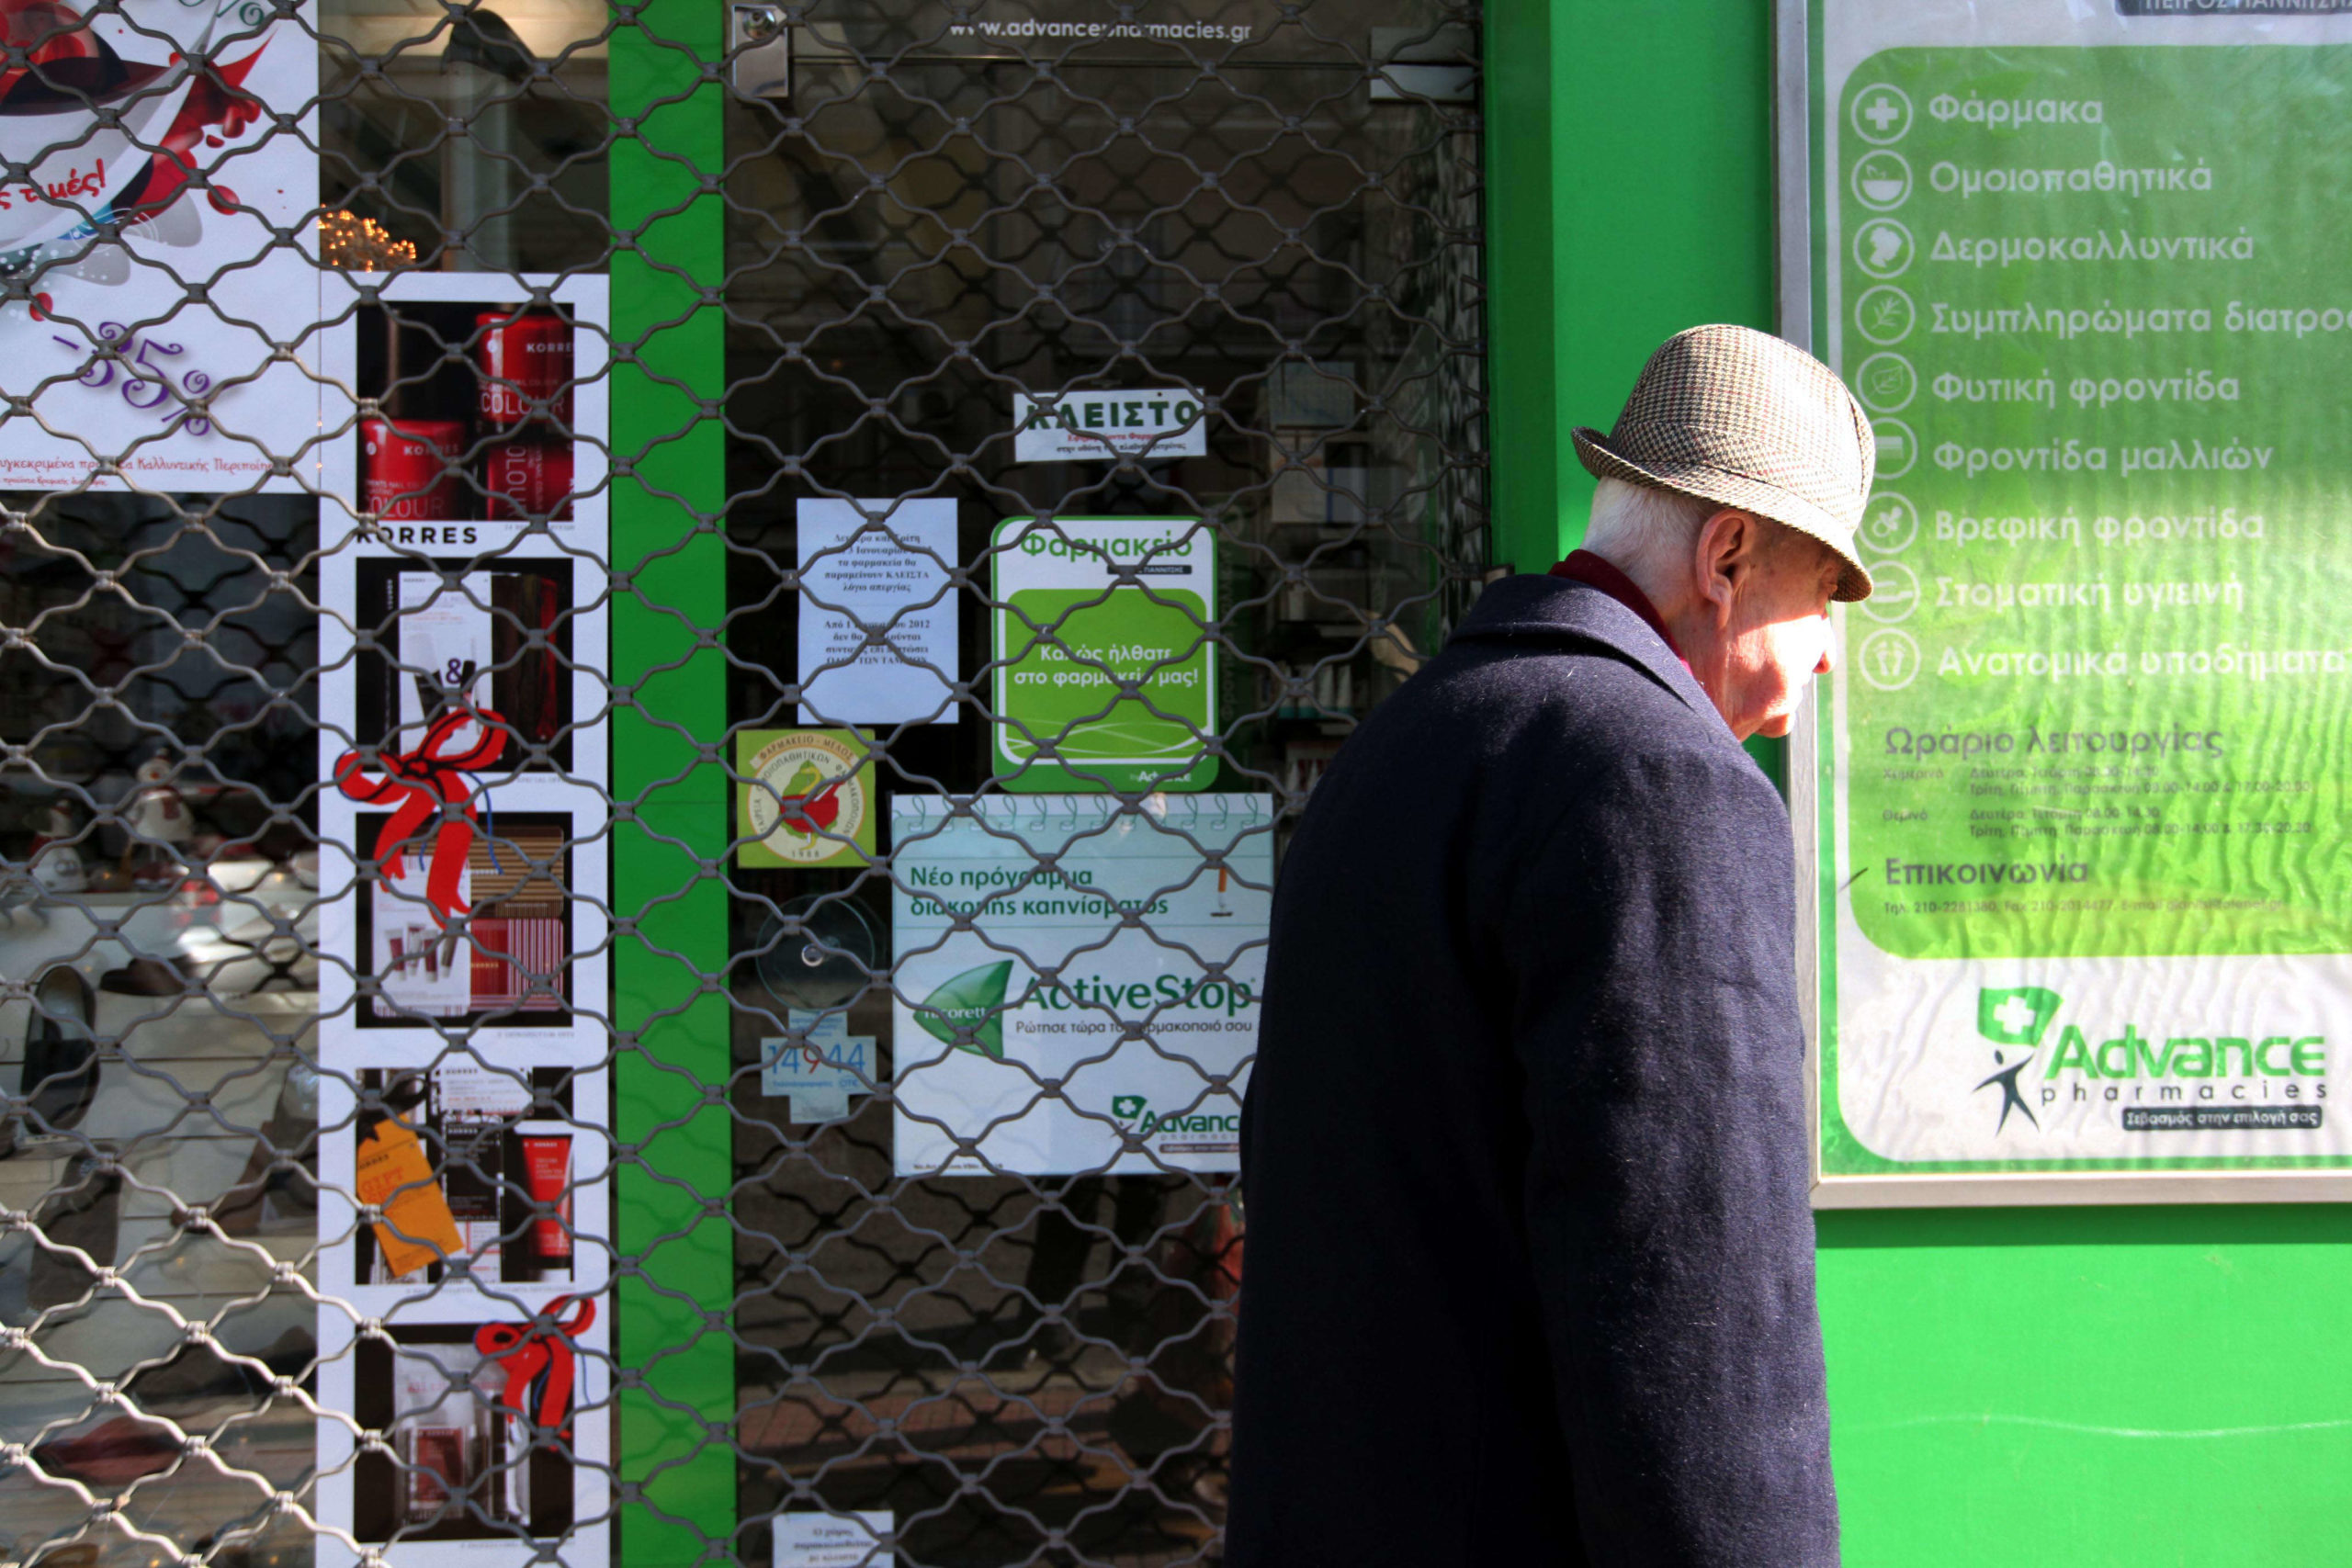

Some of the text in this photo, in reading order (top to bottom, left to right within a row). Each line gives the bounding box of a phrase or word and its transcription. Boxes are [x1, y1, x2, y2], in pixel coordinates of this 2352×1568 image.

[1929, 90, 2104, 130] Φάρμακα
[19, 158, 107, 203] τμές!
[1929, 159, 2213, 198] Ομοιοπαθητικά
[1929, 227, 2255, 266] Δερμοκαλλυντικά
[1929, 300, 2212, 339] Συμπληρώματα
[480, 392, 565, 415] COLOR
[1932, 369, 2240, 409] Φυτική φροντίδα
[1026, 400, 1199, 430] ΚΛΕΙΣΤΟ
[1933, 438, 2275, 479] Φροντίδα μαλλιών
[356, 526, 479, 544] KORRES
[1935, 506, 2081, 547] Βρεφική
[1021, 530, 1193, 562] Φαρμακείο
[1935, 571, 2245, 613] Στοματική υγιεινή
[1109, 644, 1172, 663] ήλθατε
[1936, 642, 2345, 683] Ανατομικά υποδήματα
[1014, 671, 1047, 684] στο
[1159, 668, 1199, 687] μας!
[1884, 724, 2224, 761] Ωράριο λειτουργίας
[910, 866, 953, 886] Νέο
[1885, 854, 2088, 885] Επικοινωνία
[1023, 896, 1169, 919] καπνίσματος
[1017, 974, 1252, 1016] ActiveStop
[1225, 1021, 1252, 1032] σου
[2045, 1023, 2326, 1080] Advance
[2041, 1080, 2327, 1106] pharmacies
[1139, 1110, 1241, 1134] Advanc
